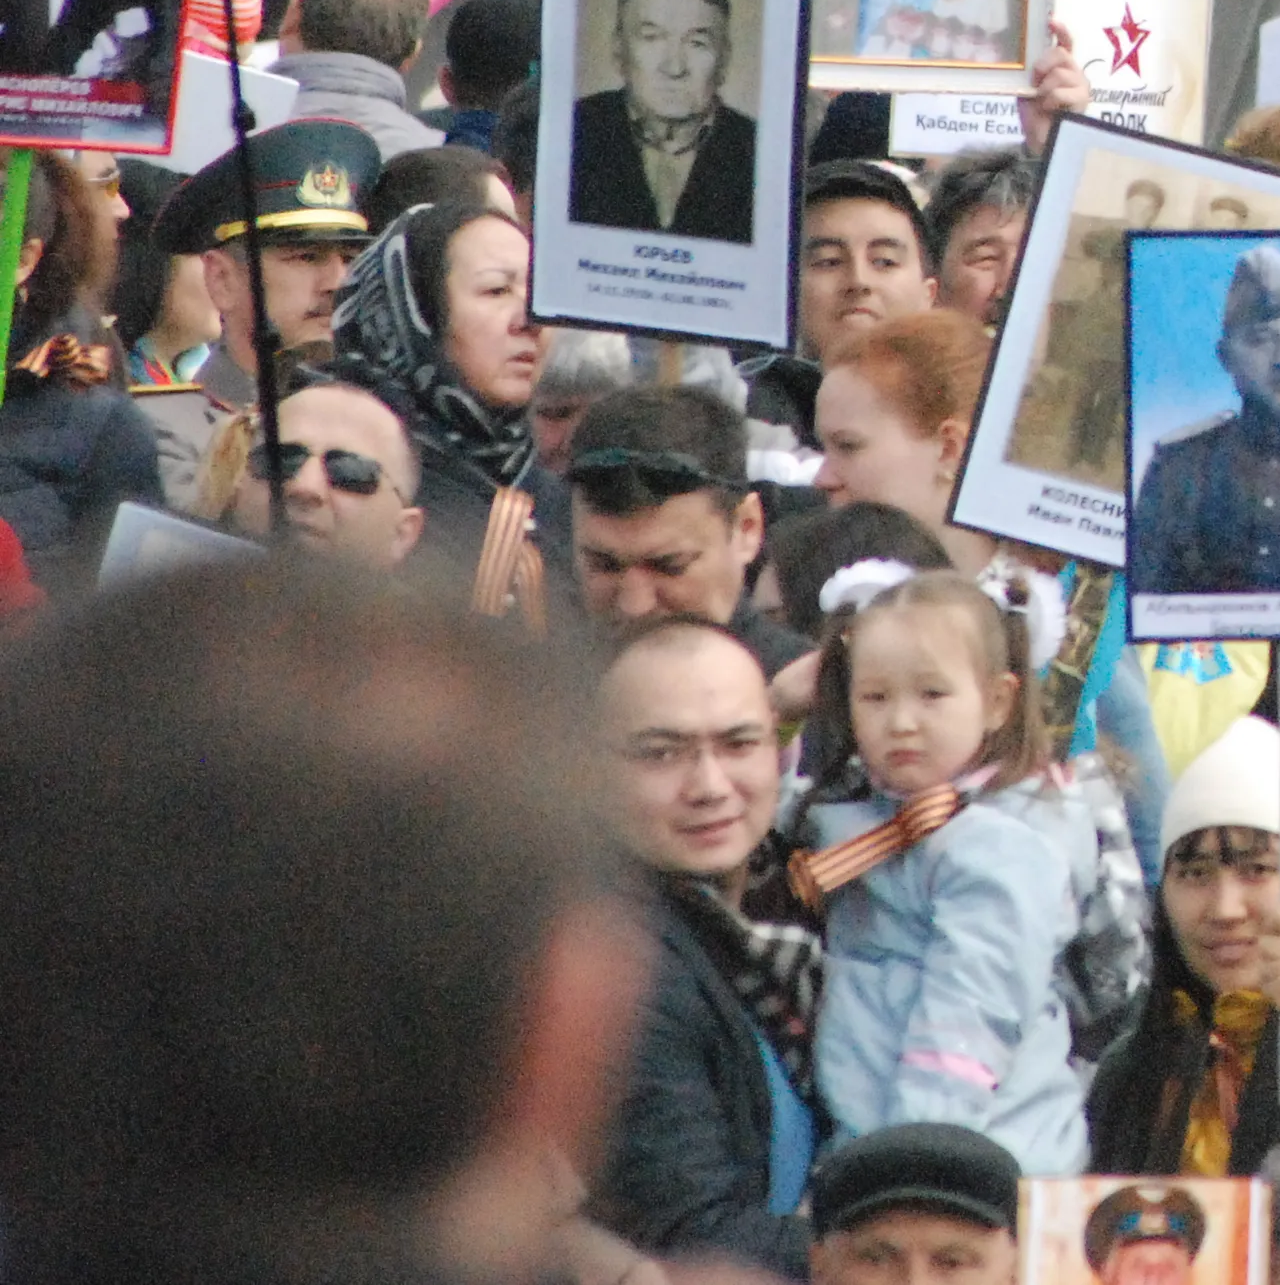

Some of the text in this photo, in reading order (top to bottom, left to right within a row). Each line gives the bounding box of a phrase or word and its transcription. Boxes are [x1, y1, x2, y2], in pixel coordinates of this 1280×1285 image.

[1084, 76, 1174, 110] ессмертный
[915, 112, 1020, 135] Қабден Есм
[632, 244, 695, 264] ЮРЬЕВ
[644, 268, 747, 292] Михайлович
[1040, 485, 1125, 519] КОЛЕСНИ
[1077, 517, 1125, 539] Павл
